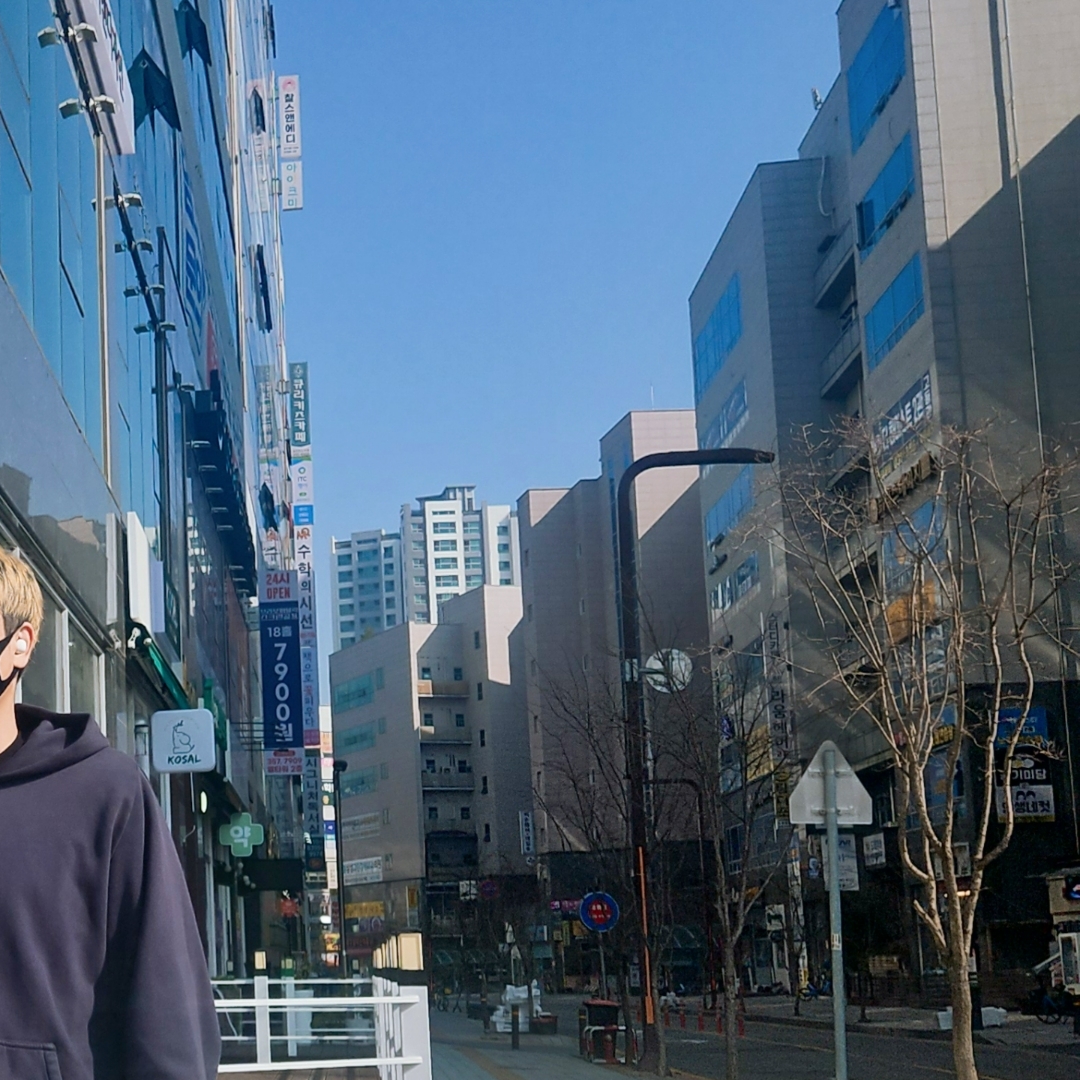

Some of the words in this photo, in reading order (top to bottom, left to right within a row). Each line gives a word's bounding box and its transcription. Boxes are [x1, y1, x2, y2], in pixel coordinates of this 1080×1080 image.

[266, 572, 290, 585] 24시
[266, 586, 291, 599] OPEN
[167, 754, 202, 765] KOSAL
[229, 825, 252, 848] 약
